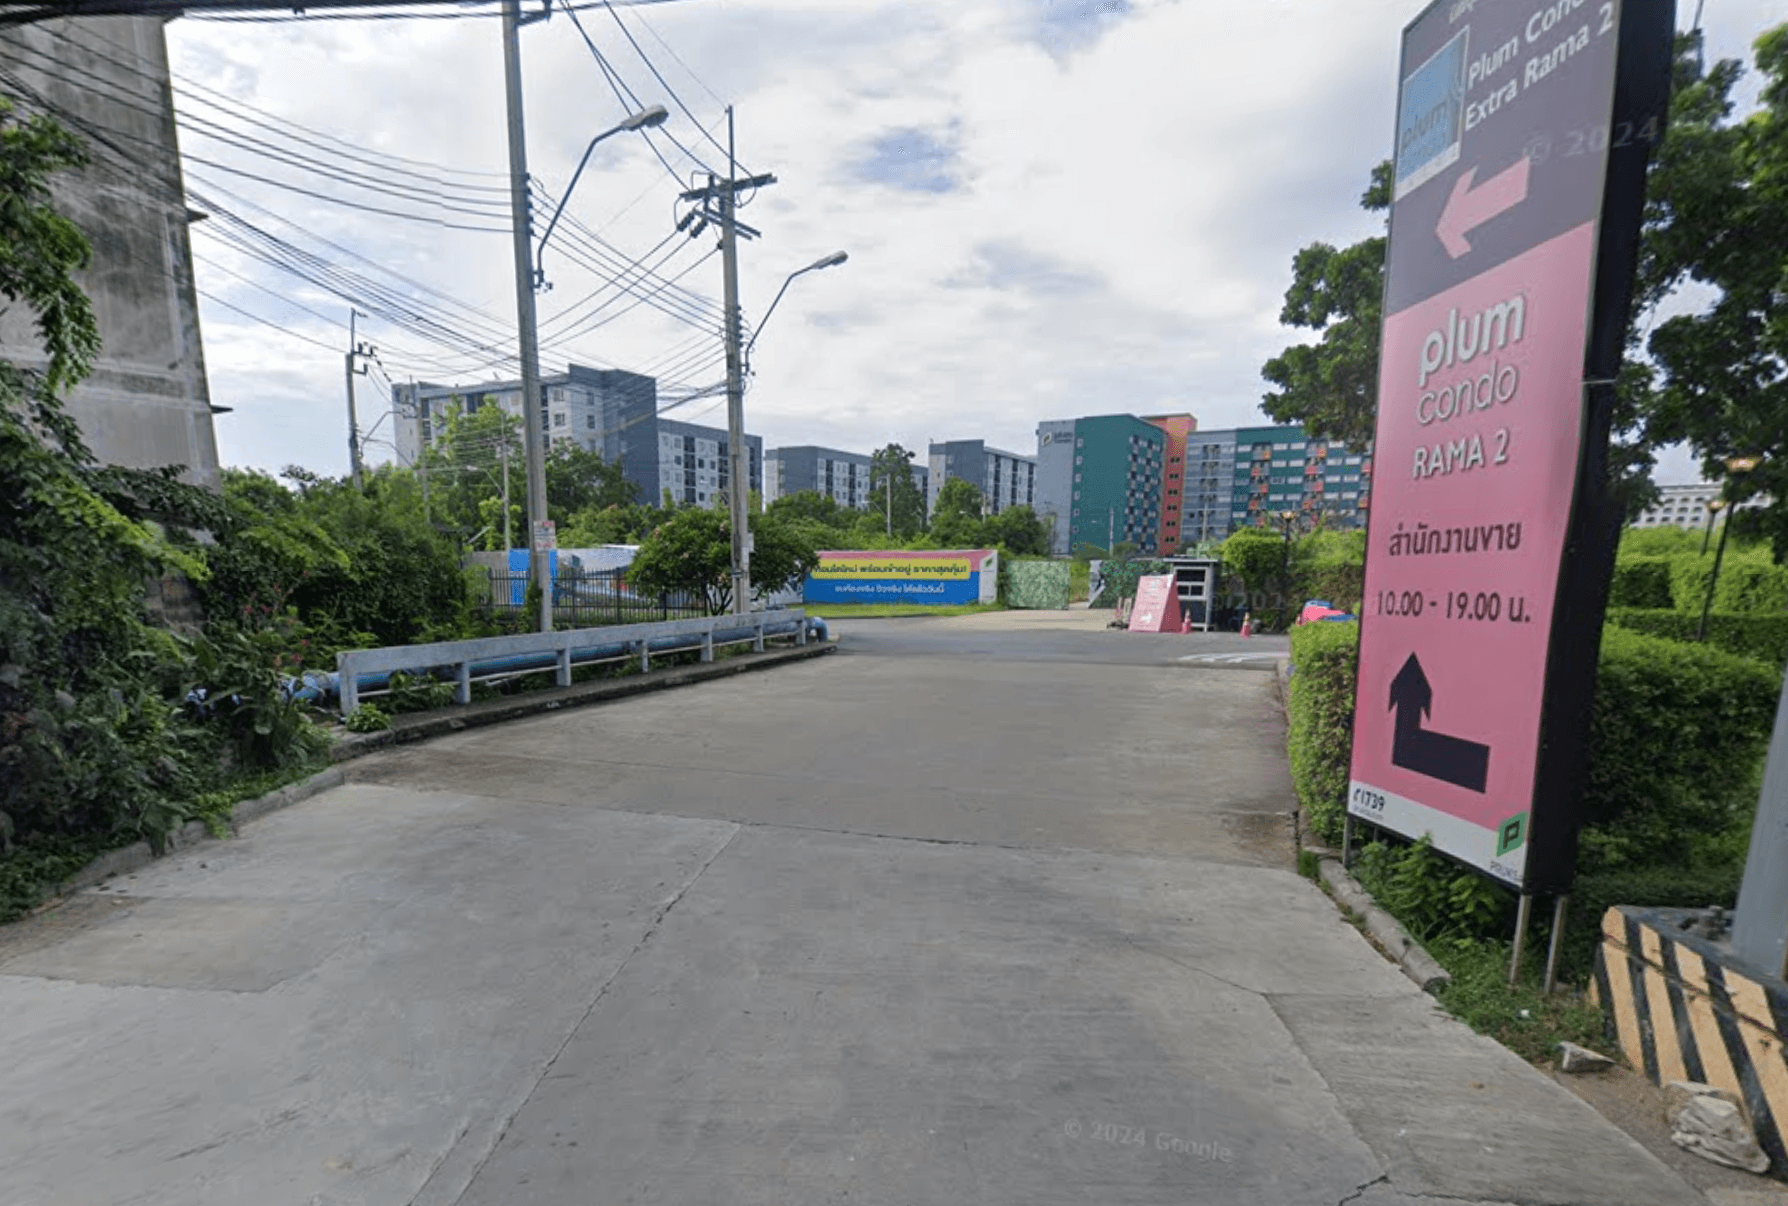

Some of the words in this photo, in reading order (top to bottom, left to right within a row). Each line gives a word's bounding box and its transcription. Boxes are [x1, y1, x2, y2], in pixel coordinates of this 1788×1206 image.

[1464, 78, 1518, 131] Extra
[1523, 24, 1590, 89] Rama
[1597, 2, 1614, 37] 2
[1467, 35, 1519, 90] Plum
[1417, 294, 1525, 387] plum
[1416, 360, 1519, 427] condo
[1412, 434, 1485, 480] RAMA
[1494, 427, 1511, 467] 2
[1388, 521, 1523, 556] สำนักงานขาย
[1377, 589, 1424, 617] 10.00
[1446, 591, 1501, 620] 19.00
[1508, 596, 1531, 623] น.
